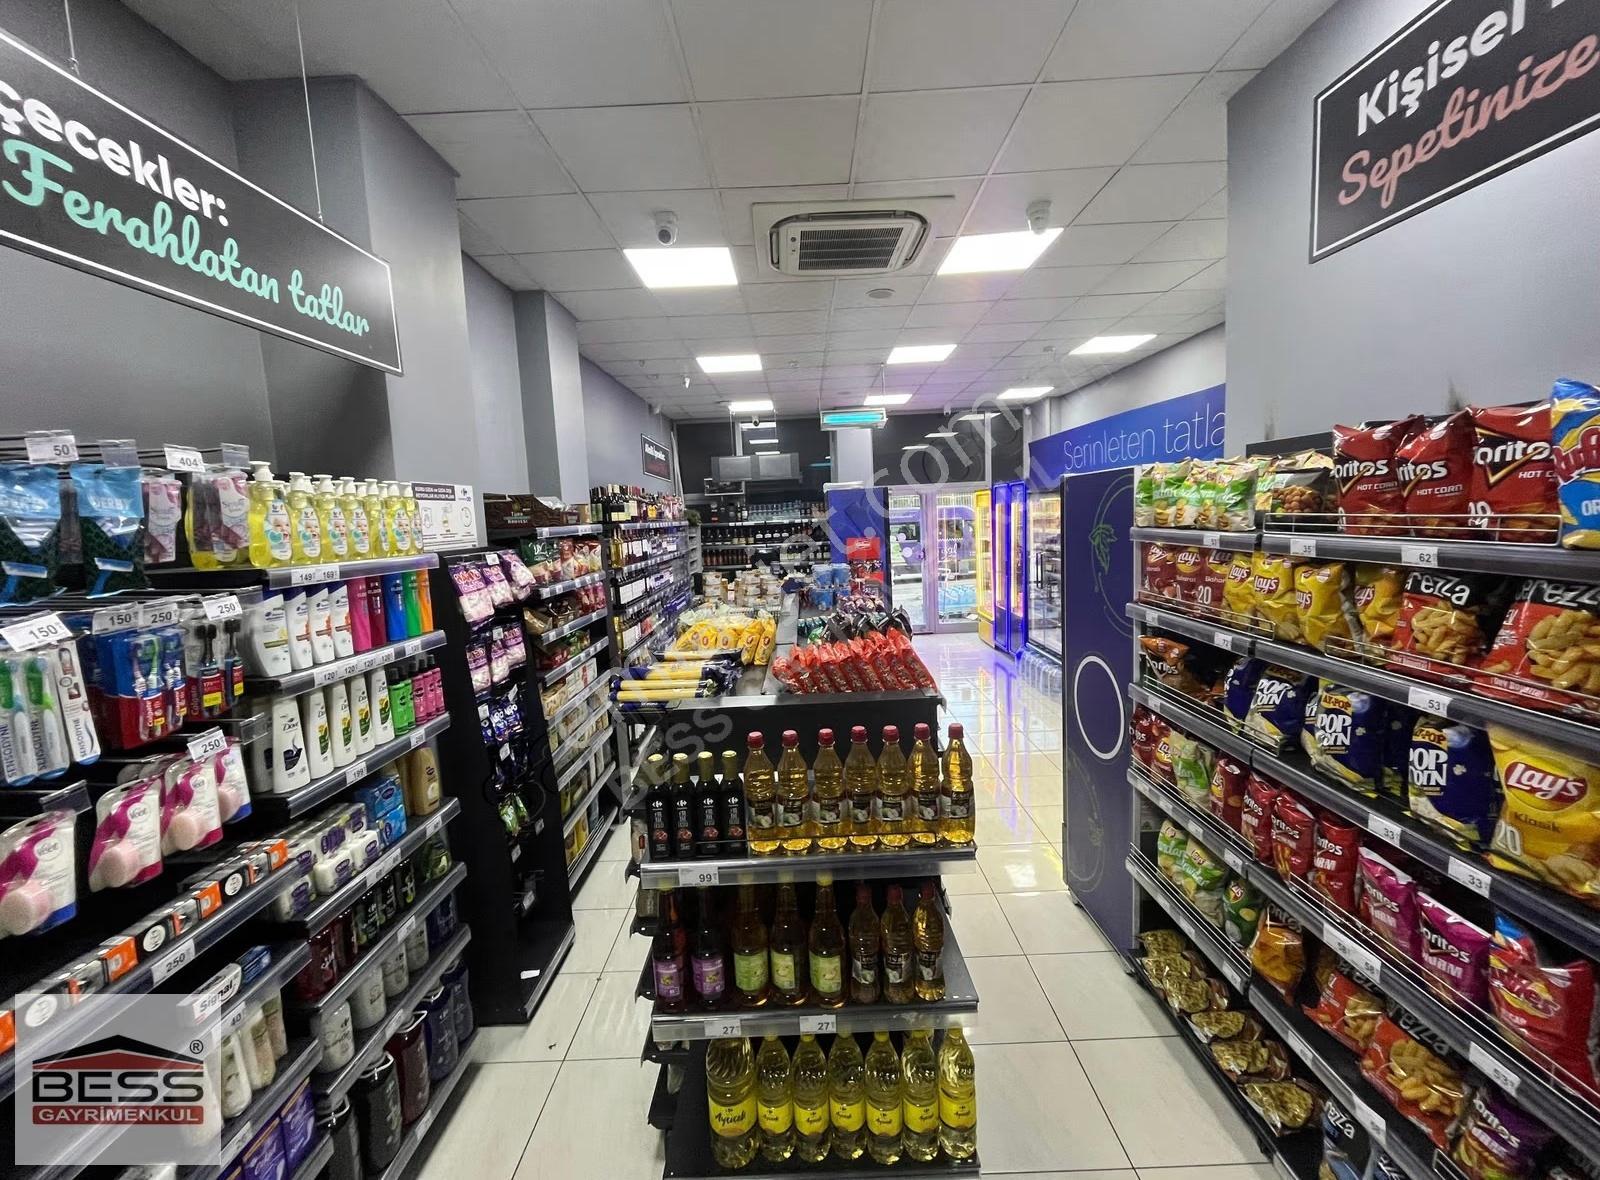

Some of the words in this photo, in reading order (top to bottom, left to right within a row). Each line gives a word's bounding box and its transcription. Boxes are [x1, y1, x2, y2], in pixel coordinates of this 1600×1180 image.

[1357, 0, 1526, 136] Kişisel
[1338, 34, 1600, 209] Sepetinize
[2, 138, 280, 304] Ferahlatan
[288, 269, 370, 338] tatlar
[53, 444, 70, 456] 50
[1063, 427, 1156, 471] Serinleten
[178, 457, 199, 467] 404
[1518, 470, 1543, 479] HOT
[1416, 488, 1433, 496] HOT
[1434, 484, 1463, 495] CORN
[1419, 552, 1432, 562] 62
[217, 604, 237, 614] 250
[109, 613, 133, 626] 150
[150, 611, 173, 624] 250
[29, 625, 58, 640] 150
[1258, 679, 1292, 695] POP
[1427, 699, 1441, 711] 53
[282, 721, 300, 732] Dove
[1315, 713, 1352, 734] POP
[201, 738, 221, 754] 250
[1383, 829, 1395, 840] 33
[698, 873, 713, 883] 99
[1467, 874, 1483, 889] 33
[166, 952, 186, 972] 250
[199, 980, 234, 1013] Signal
[722, 1026, 735, 1035] 27
[818, 1022, 830, 1031] 27
